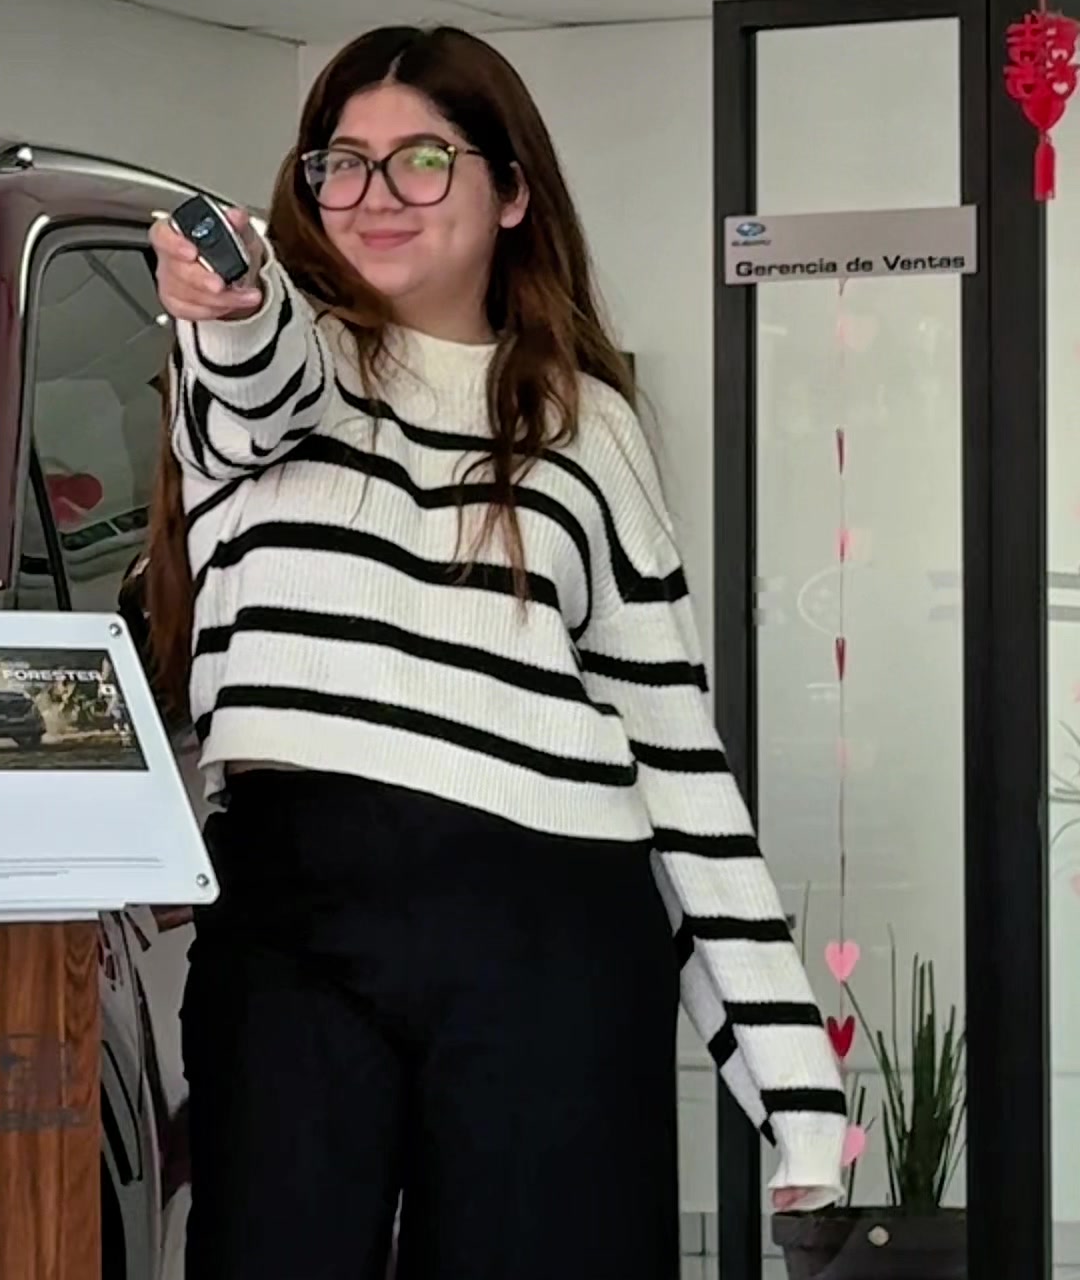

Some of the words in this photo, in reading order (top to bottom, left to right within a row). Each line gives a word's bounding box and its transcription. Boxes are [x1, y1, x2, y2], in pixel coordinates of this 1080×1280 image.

[735, 257, 838, 278] Gerencia
[846, 257, 873, 273] de
[883, 254, 966, 271] Ventas
[2, 668, 104, 682] FORESTER
